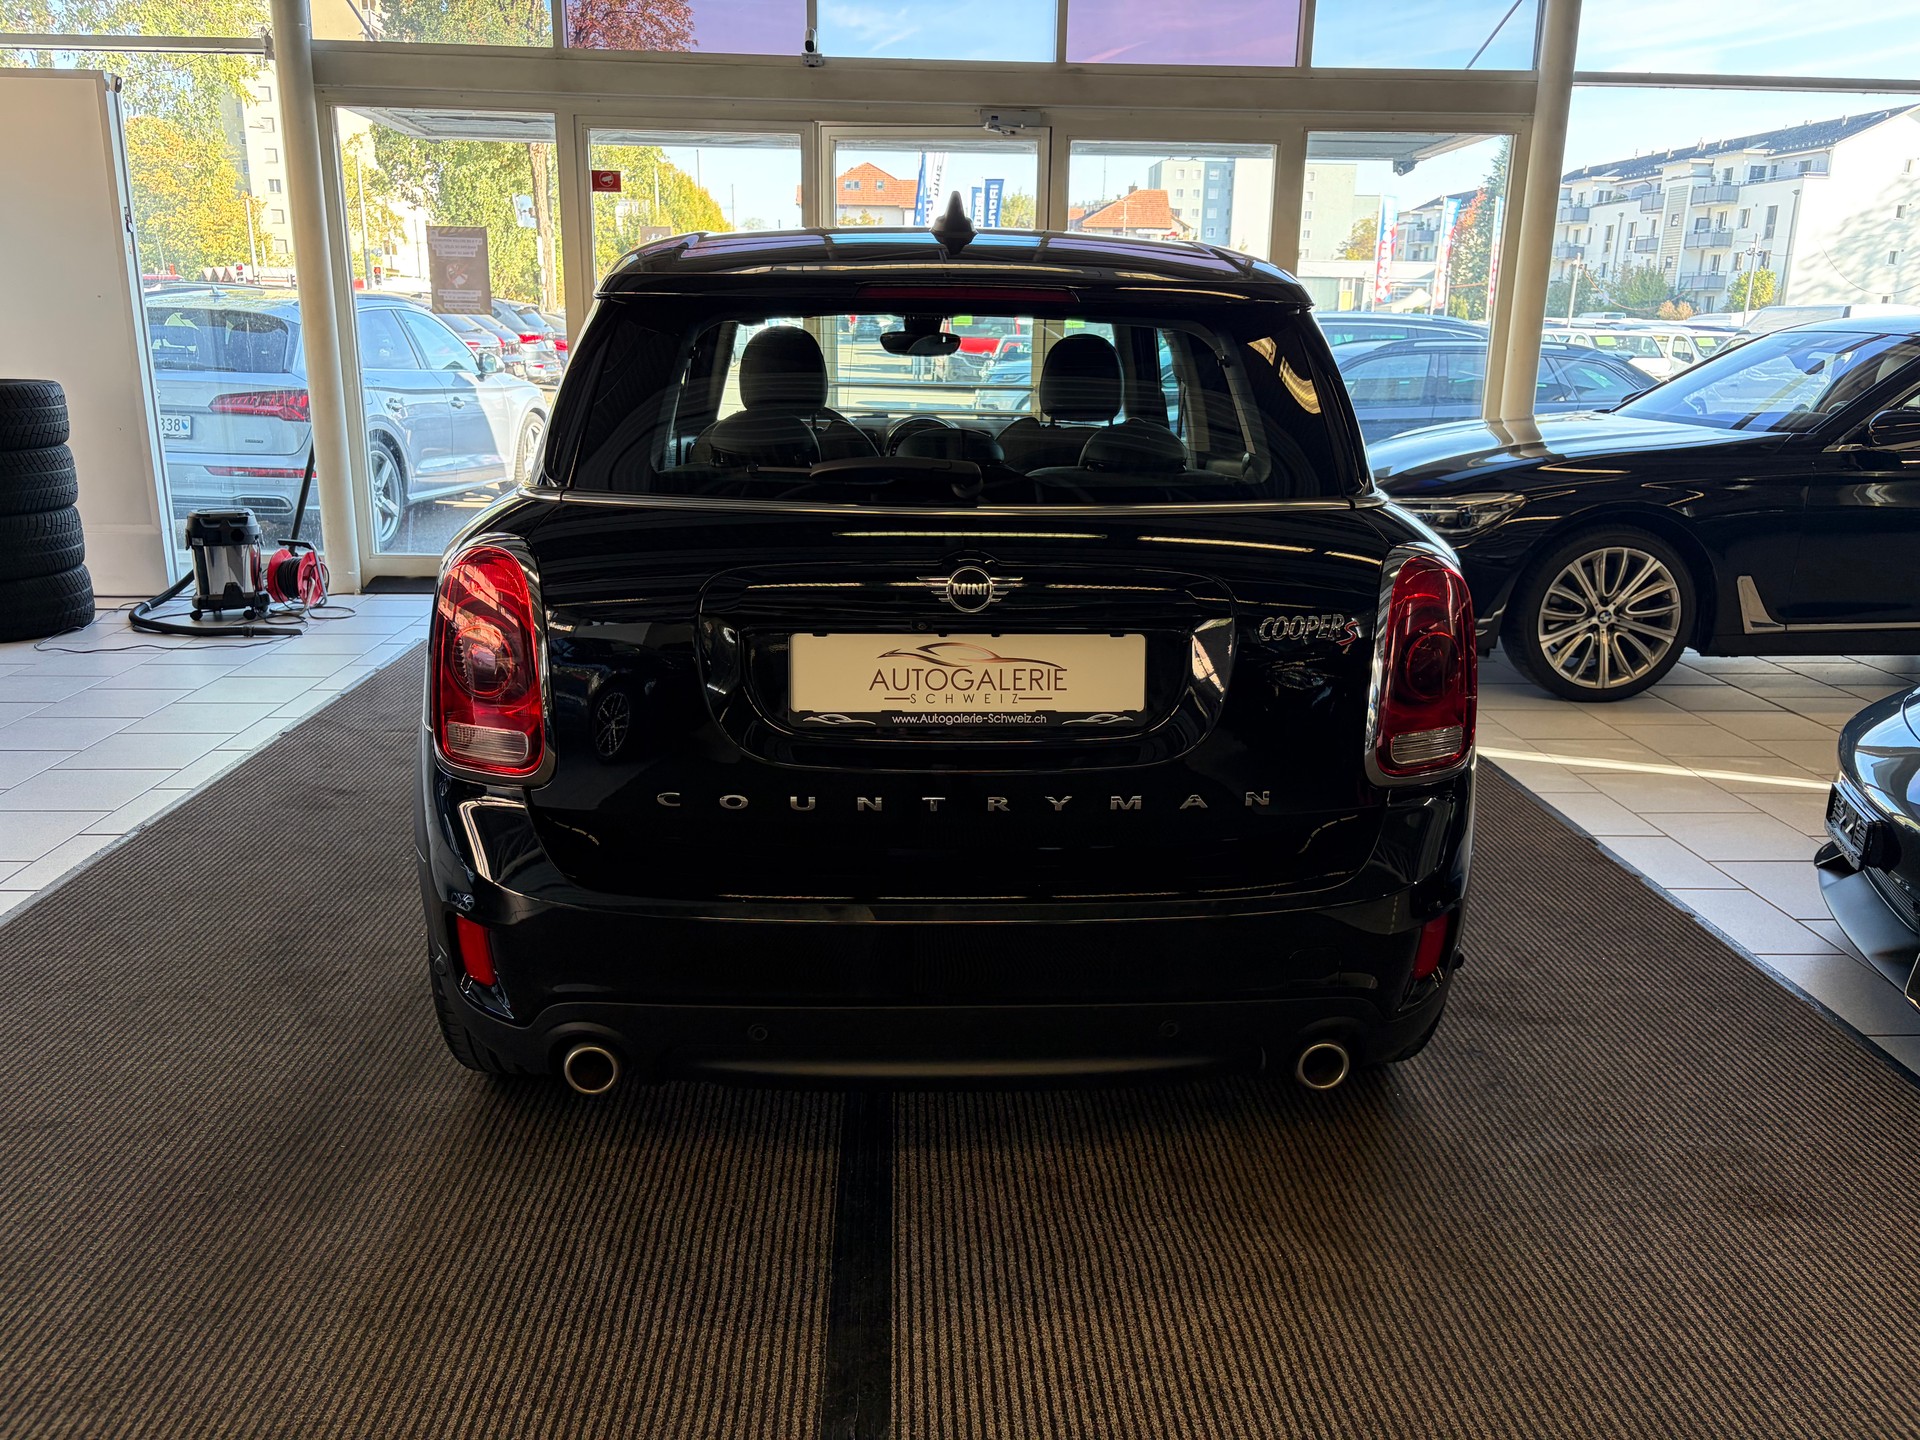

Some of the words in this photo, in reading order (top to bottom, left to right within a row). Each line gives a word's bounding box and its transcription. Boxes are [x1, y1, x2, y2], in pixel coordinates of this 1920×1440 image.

[952, 583, 988, 595] MINI
[1259, 613, 1345, 642] COOPER
[1336, 618, 1361, 646] S
[868, 667, 1068, 692] AUTOGALERIE
[910, 693, 1019, 705] SCHWEIZ
[891, 713, 1047, 726] www.Autogalerie-Schweiz.ch
[656, 790, 1271, 812] COUNTRYMAN
